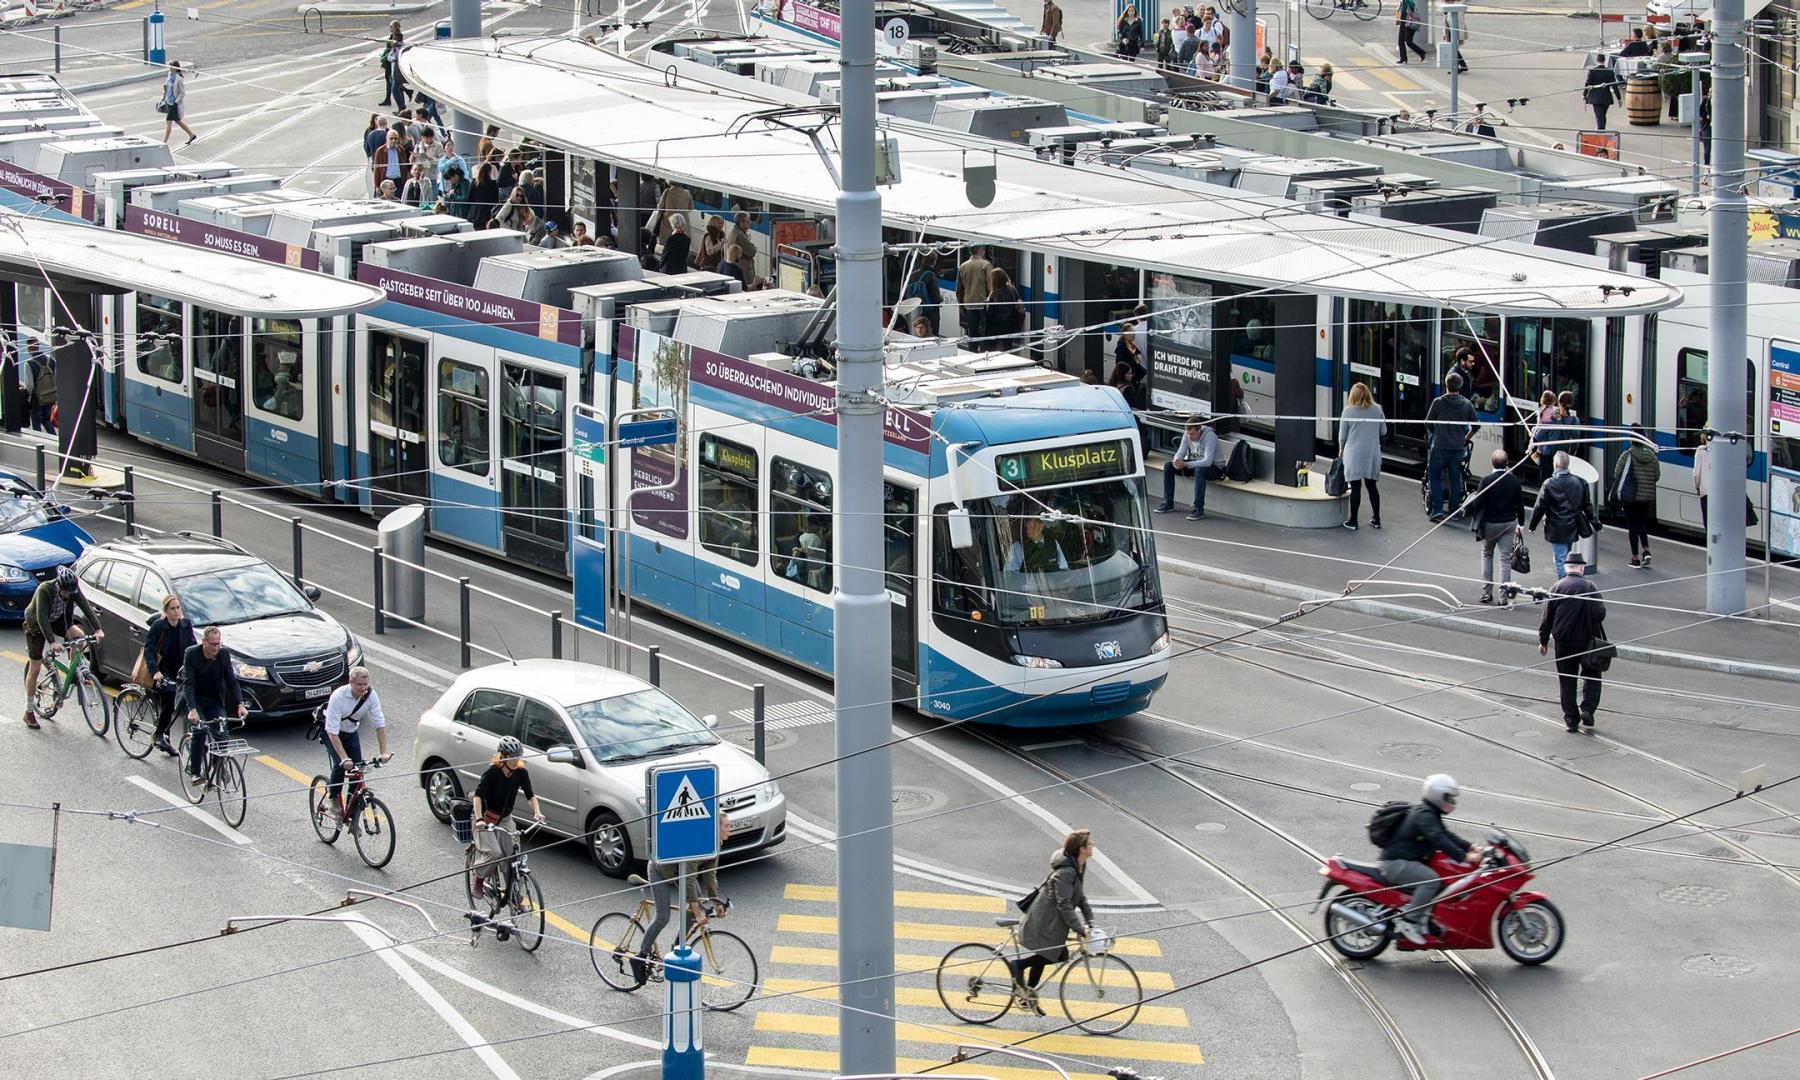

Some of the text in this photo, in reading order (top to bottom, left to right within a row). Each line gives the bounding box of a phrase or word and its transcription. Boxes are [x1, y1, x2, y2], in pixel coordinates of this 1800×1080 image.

[889, 25, 904, 39] 18
[143, 213, 181, 234] SORELL
[204, 233, 260, 257] SO MUSS ES SEIN.
[379, 277, 516, 321] GASTGEBER SEIT ÜBER 100 JAHREN.
[1154, 350, 1203, 369] ICH WERDE MIT
[1771, 360, 1790, 369] Central
[706, 361, 717, 377] SO
[718, 362, 783, 397] ÜBERRASCHEND
[1154, 361, 1178, 374] DRAHT
[1178, 366, 1211, 383] ERWÜRGT.
[1775, 376, 1781, 386] 6
[1775, 392, 1781, 401] 7
[1773, 408, 1781, 418] 10
[1006, 447, 1117, 478] 3 Klusplatz
[633, 468, 662, 486] HERRLICH
[933, 699, 951, 711] 3040
